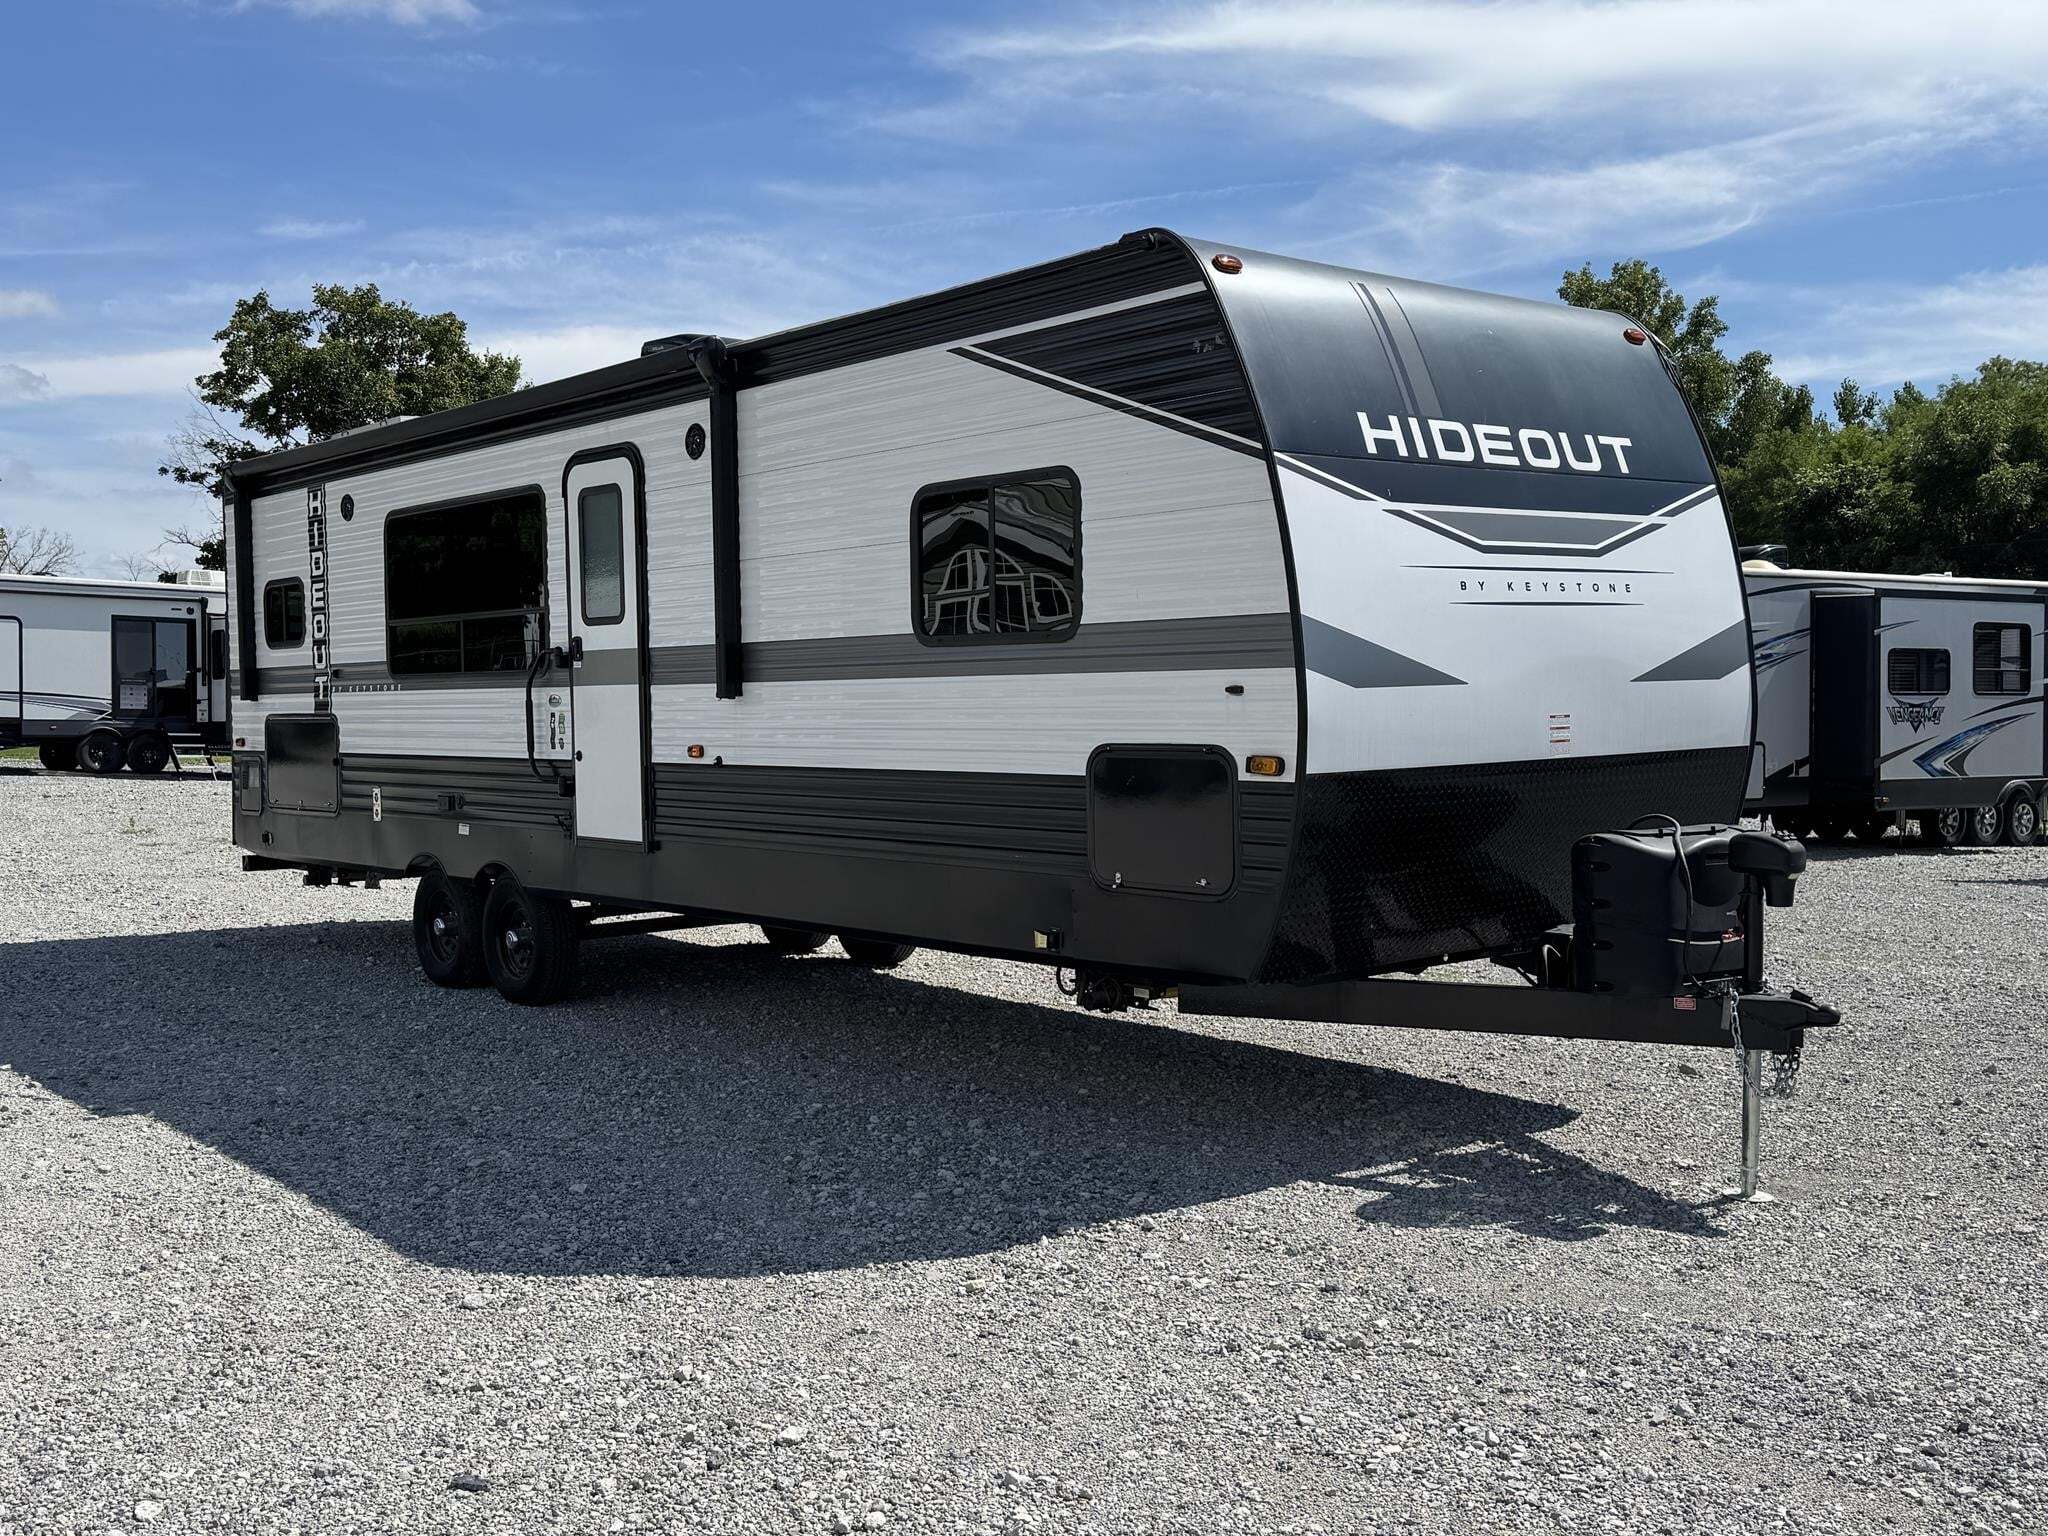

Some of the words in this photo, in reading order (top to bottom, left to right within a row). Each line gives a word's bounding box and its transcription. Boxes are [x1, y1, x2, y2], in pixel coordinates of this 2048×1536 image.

[1356, 411, 1633, 474] HIDEOUT
[309, 490, 328, 699] HIDEOUT
[1460, 581, 1485, 592] BY
[1507, 582, 1632, 593] KEYSTONE
